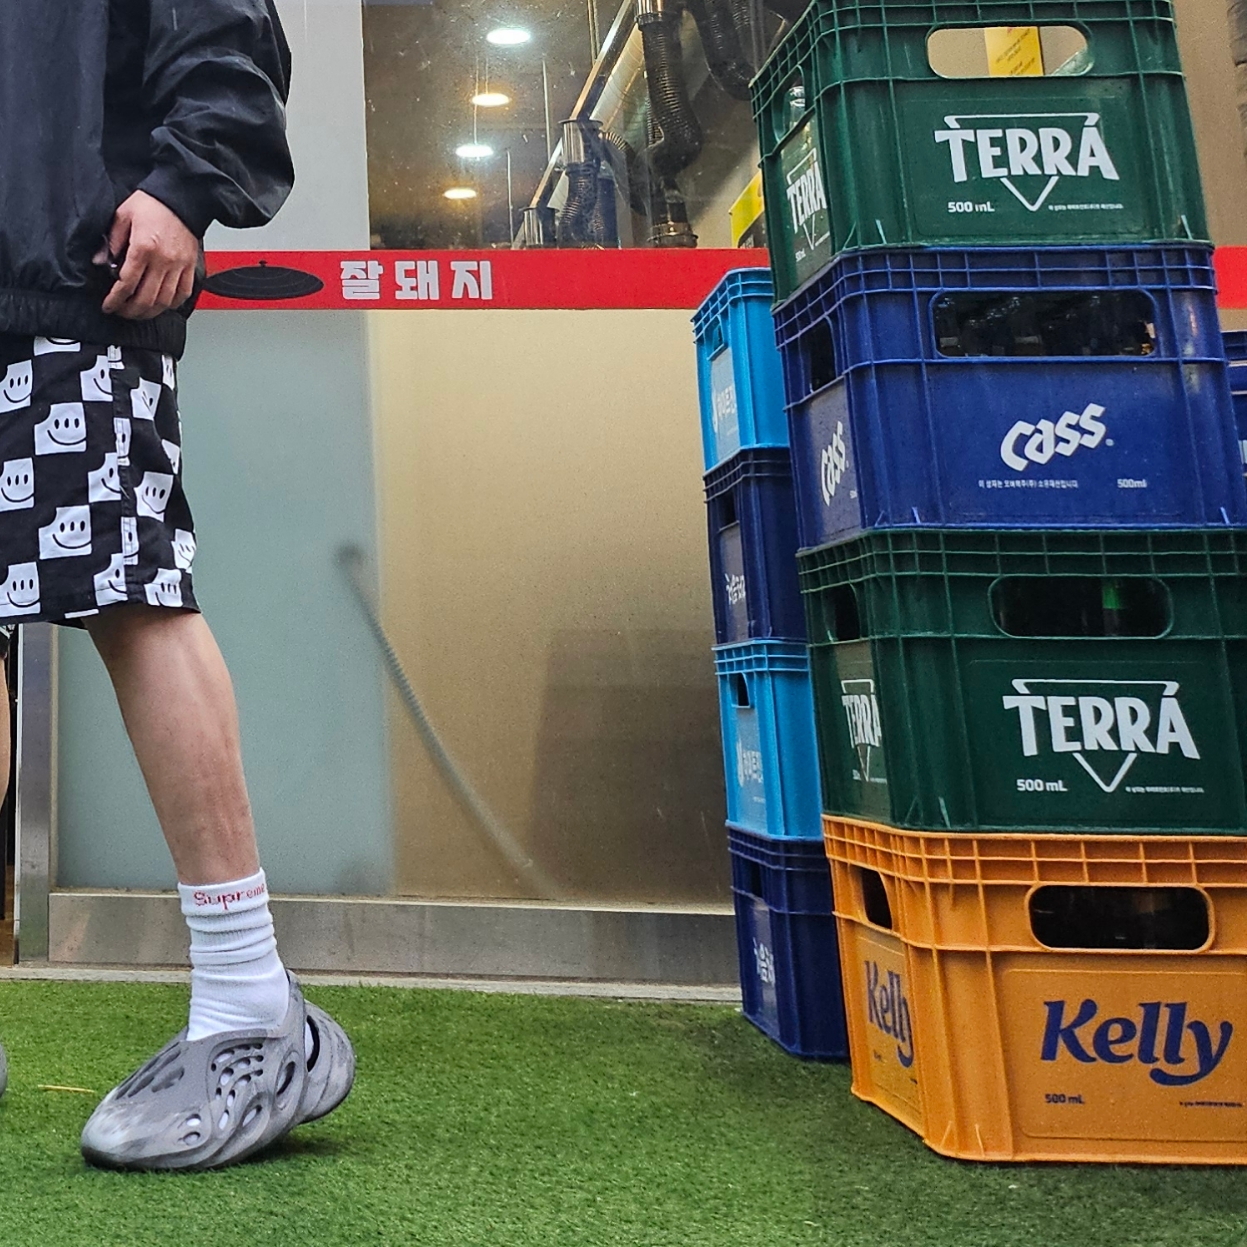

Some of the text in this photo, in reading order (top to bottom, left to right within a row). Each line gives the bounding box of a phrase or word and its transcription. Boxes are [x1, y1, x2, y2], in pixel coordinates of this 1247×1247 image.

[934, 126, 1120, 183] TERRA
[786, 160, 827, 234] TERRA
[948, 202, 973, 213] 500
[340, 260, 493, 301] 잘돼지
[841, 693, 882, 749] TERRA
[1003, 695, 1201, 760] TERRA
[1017, 779, 1068, 792] 500 mL
[864, 960, 914, 1068] Kelly
[1041, 998, 1233, 1086] Kelly
[1045, 1093, 1066, 1104] 500
